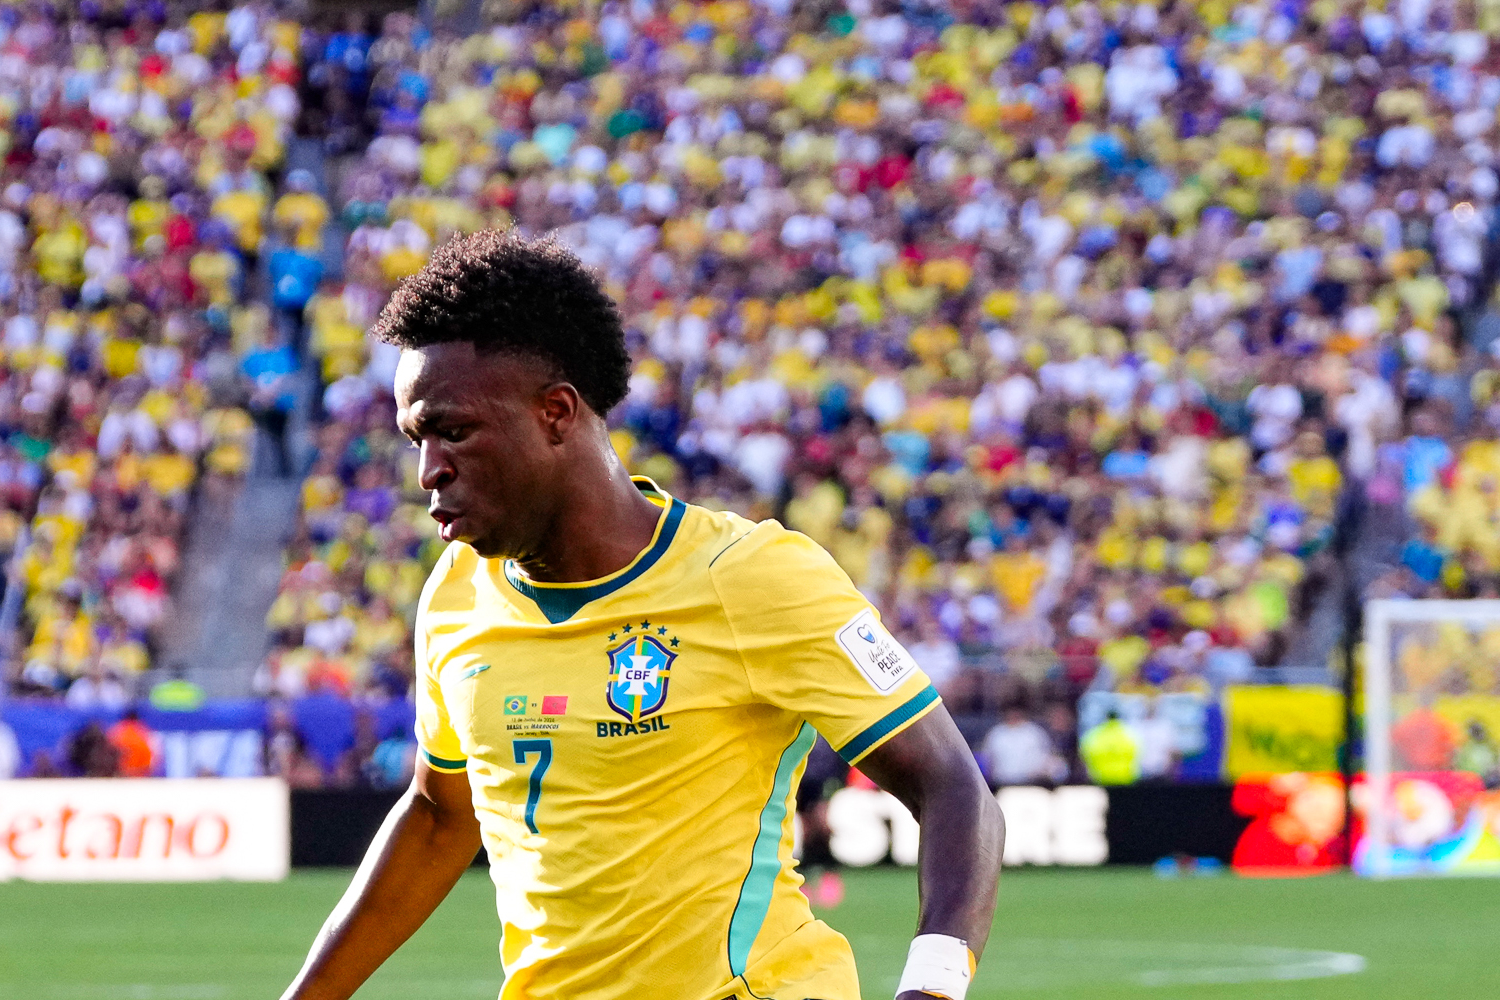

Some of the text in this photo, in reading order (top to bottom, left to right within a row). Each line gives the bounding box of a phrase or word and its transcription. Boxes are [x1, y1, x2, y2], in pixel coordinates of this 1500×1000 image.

[877, 650, 902, 674] PEACE
[890, 665, 904, 677] FIFA
[625, 669, 651, 680] CBF
[597, 715, 670, 737] BRASIL
[512, 738, 553, 834] 7
[827, 784, 1109, 867] STRE
